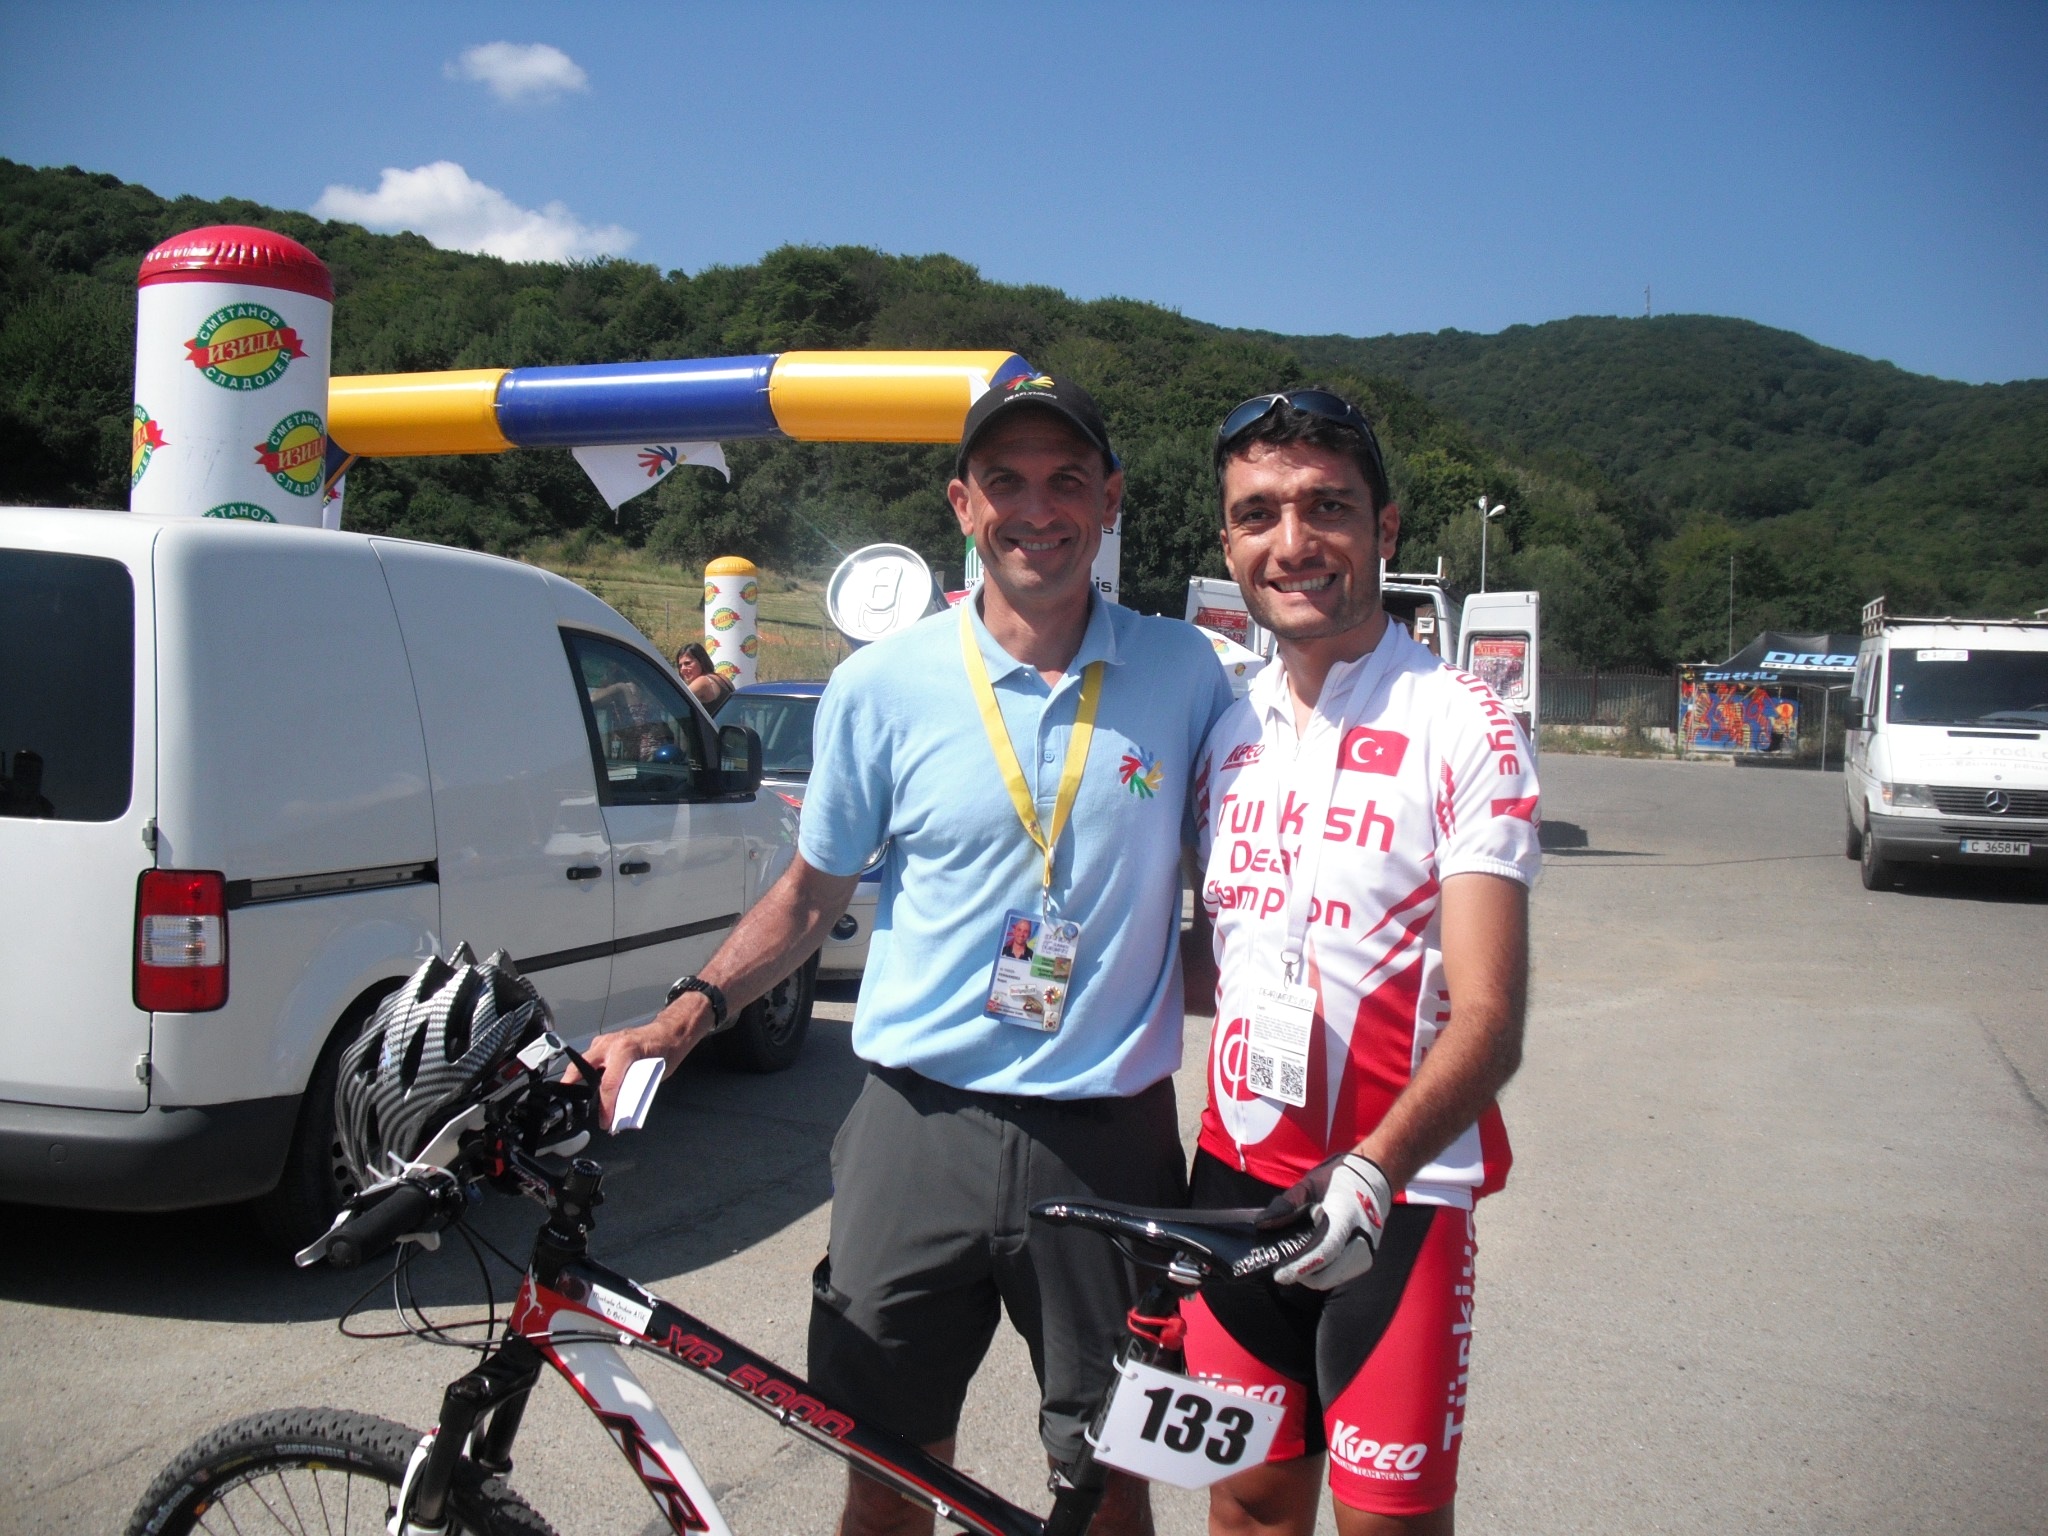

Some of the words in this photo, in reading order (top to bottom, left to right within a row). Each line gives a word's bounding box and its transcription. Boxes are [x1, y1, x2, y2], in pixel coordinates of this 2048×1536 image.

[200, 306, 280, 341] СМЕТАНОВ
[207, 330, 285, 364] ИЗИДА
[206, 350, 291, 389] СЛАДОЛЕД
[1763, 651, 1858, 667] DRA
[1207, 879, 1352, 930] Champon
[727, 1363, 856, 1439] 5000
[1140, 1386, 1255, 1466] 133
